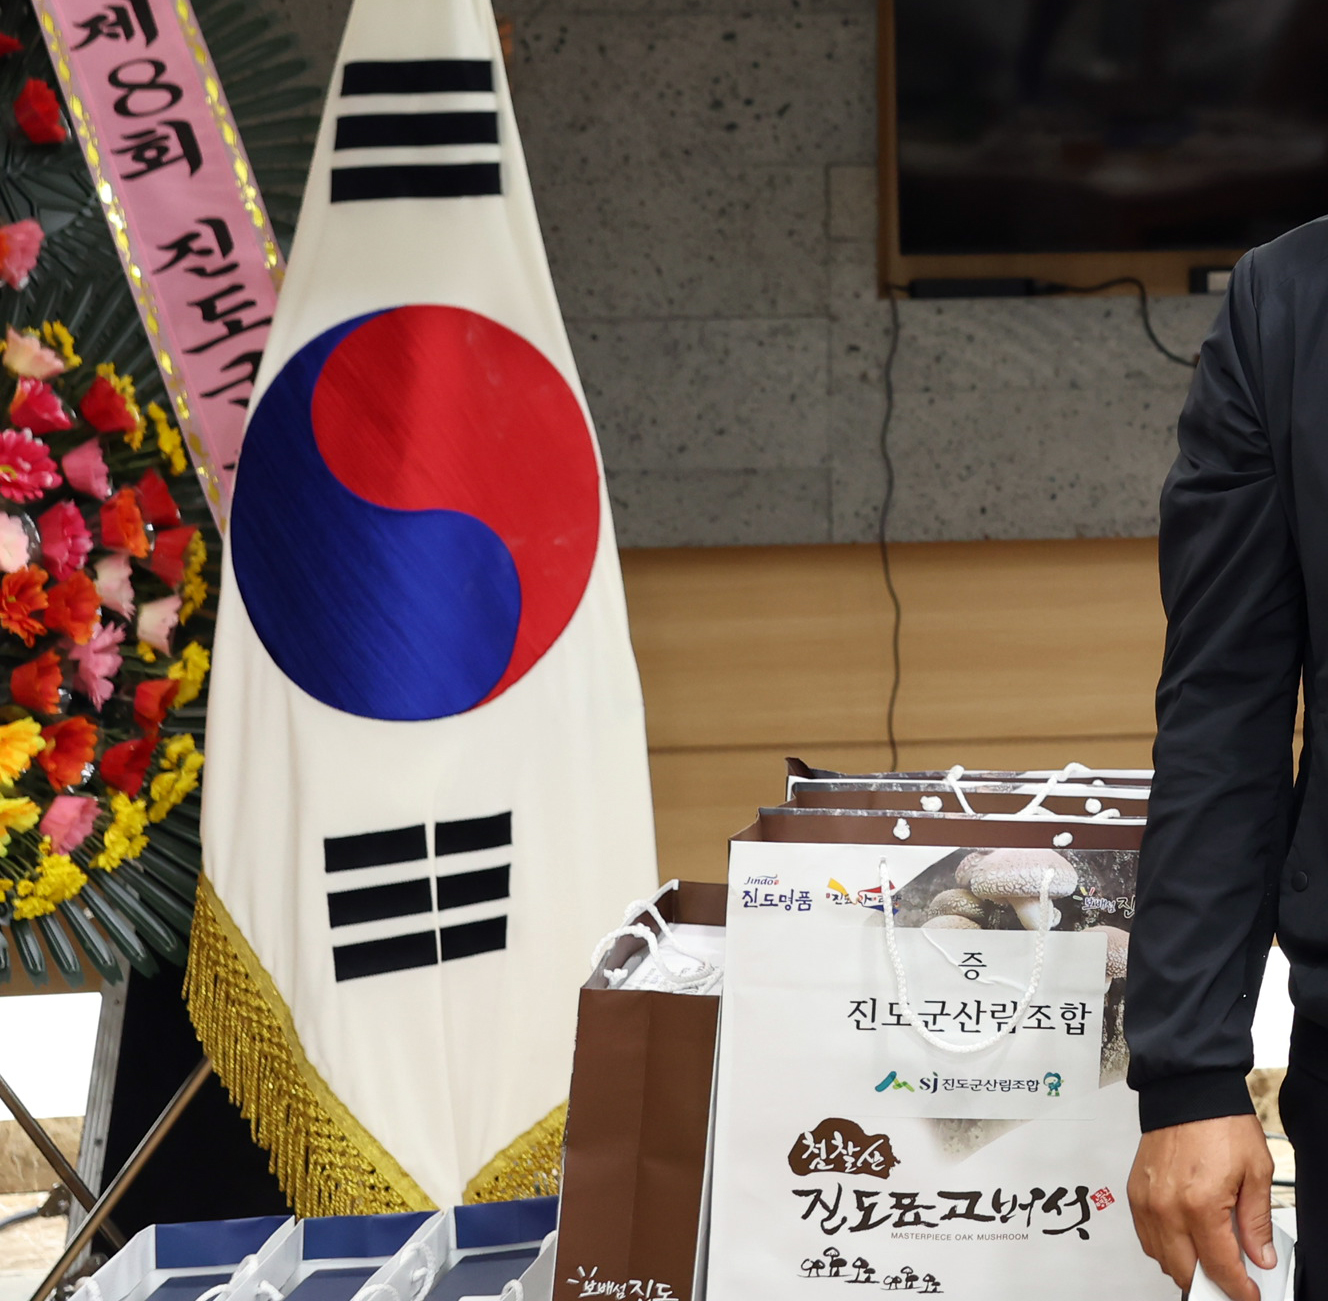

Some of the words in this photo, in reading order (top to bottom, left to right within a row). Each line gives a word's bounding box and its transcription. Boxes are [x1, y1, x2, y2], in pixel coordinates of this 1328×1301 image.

[742, 888, 813, 912] 진도명품
[958, 951, 987, 981] 증
[847, 997, 1093, 1036] 진도군산림조합
[942, 1078, 1040, 1093] 진도군산림조합
[791, 1182, 1091, 1241] 진도표고버섯
[890, 1231, 952, 1242] MASTERPIECE
[955, 1232, 974, 1242] OAK
[977, 1232, 1029, 1242] MUSHROOM
